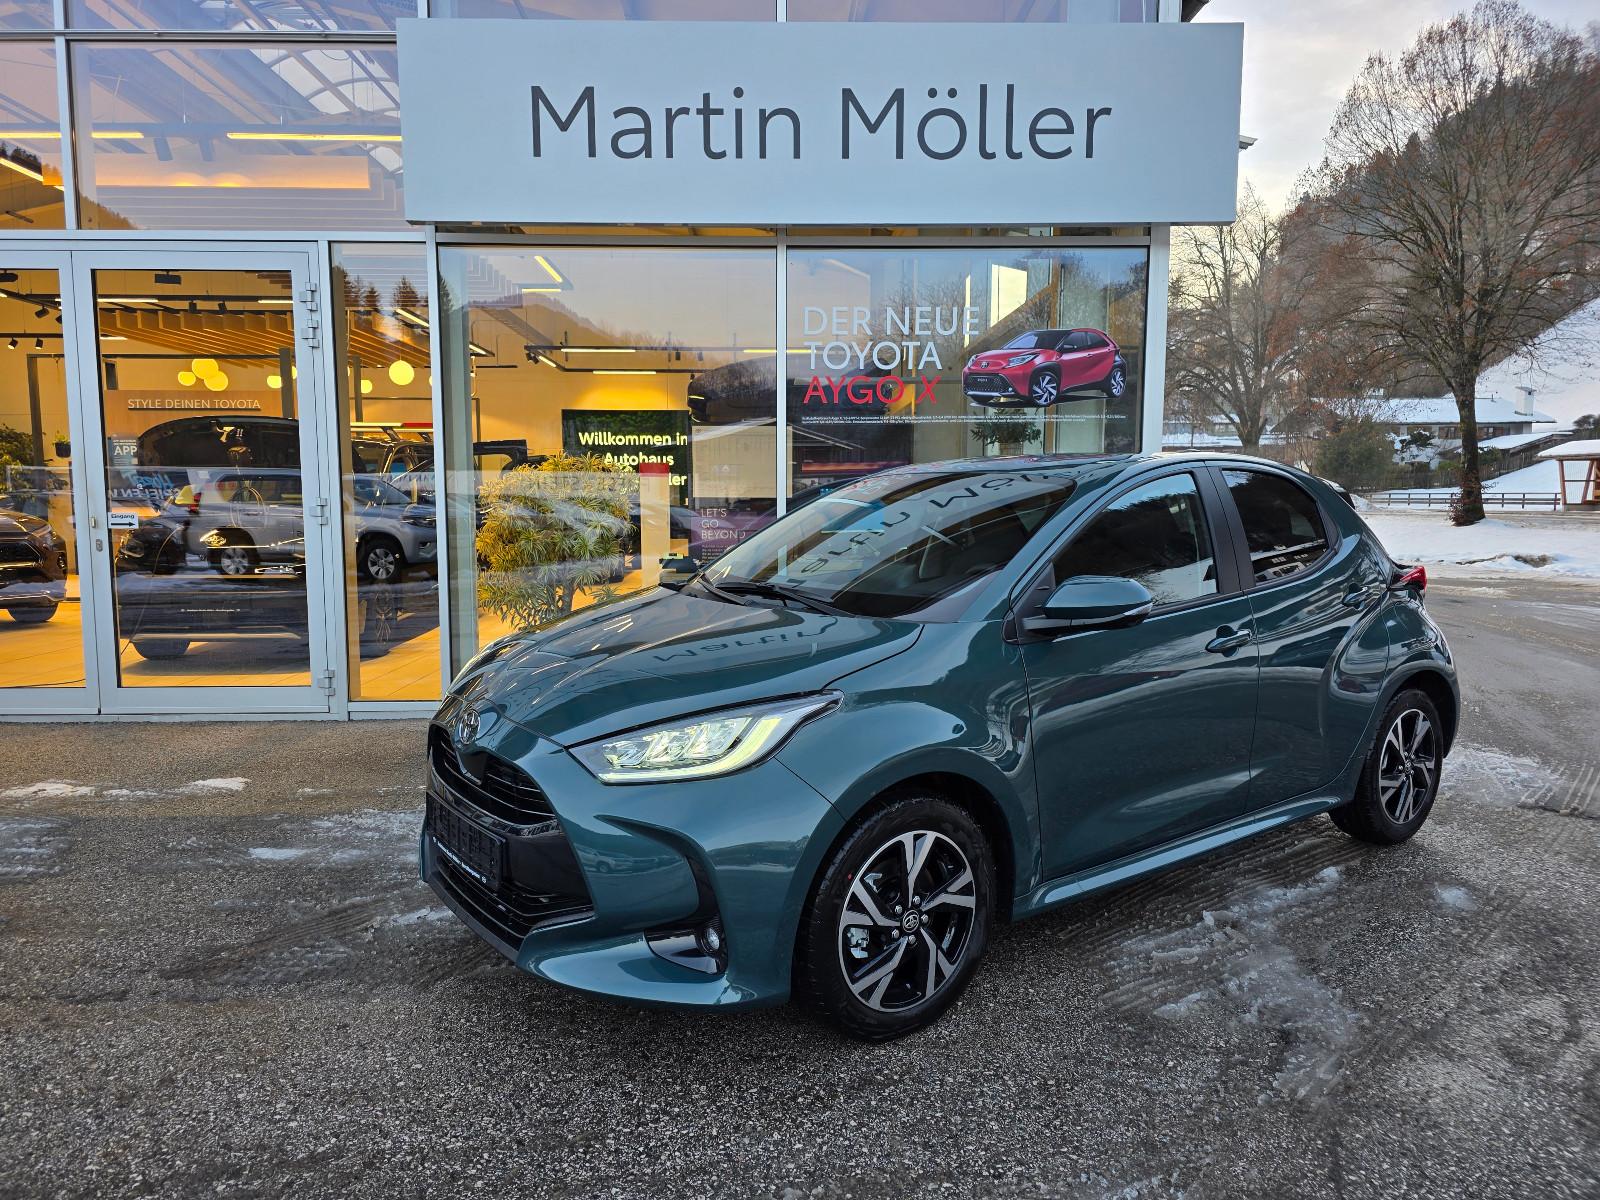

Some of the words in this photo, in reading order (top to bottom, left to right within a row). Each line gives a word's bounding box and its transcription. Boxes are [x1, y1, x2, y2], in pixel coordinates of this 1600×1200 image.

[531, 86, 801, 160] Martin
[842, 84, 1113, 160] Möller
[803, 306, 873, 336] DER
[886, 306, 980, 336] NEUE
[803, 341, 943, 370] TOYOTA
[803, 375, 905, 404] AYGO
[917, 375, 942, 404] X
[127, 399, 162, 409] STYLE
[165, 399, 211, 409] DEINEN
[213, 399, 261, 409] TOYOTA
[578, 432, 672, 446] Willkommen
[114, 446, 138, 456] APP
[604, 452, 675, 466] Autohaus
[701, 508, 727, 518] LET'S
[701, 519, 719, 529] GO
